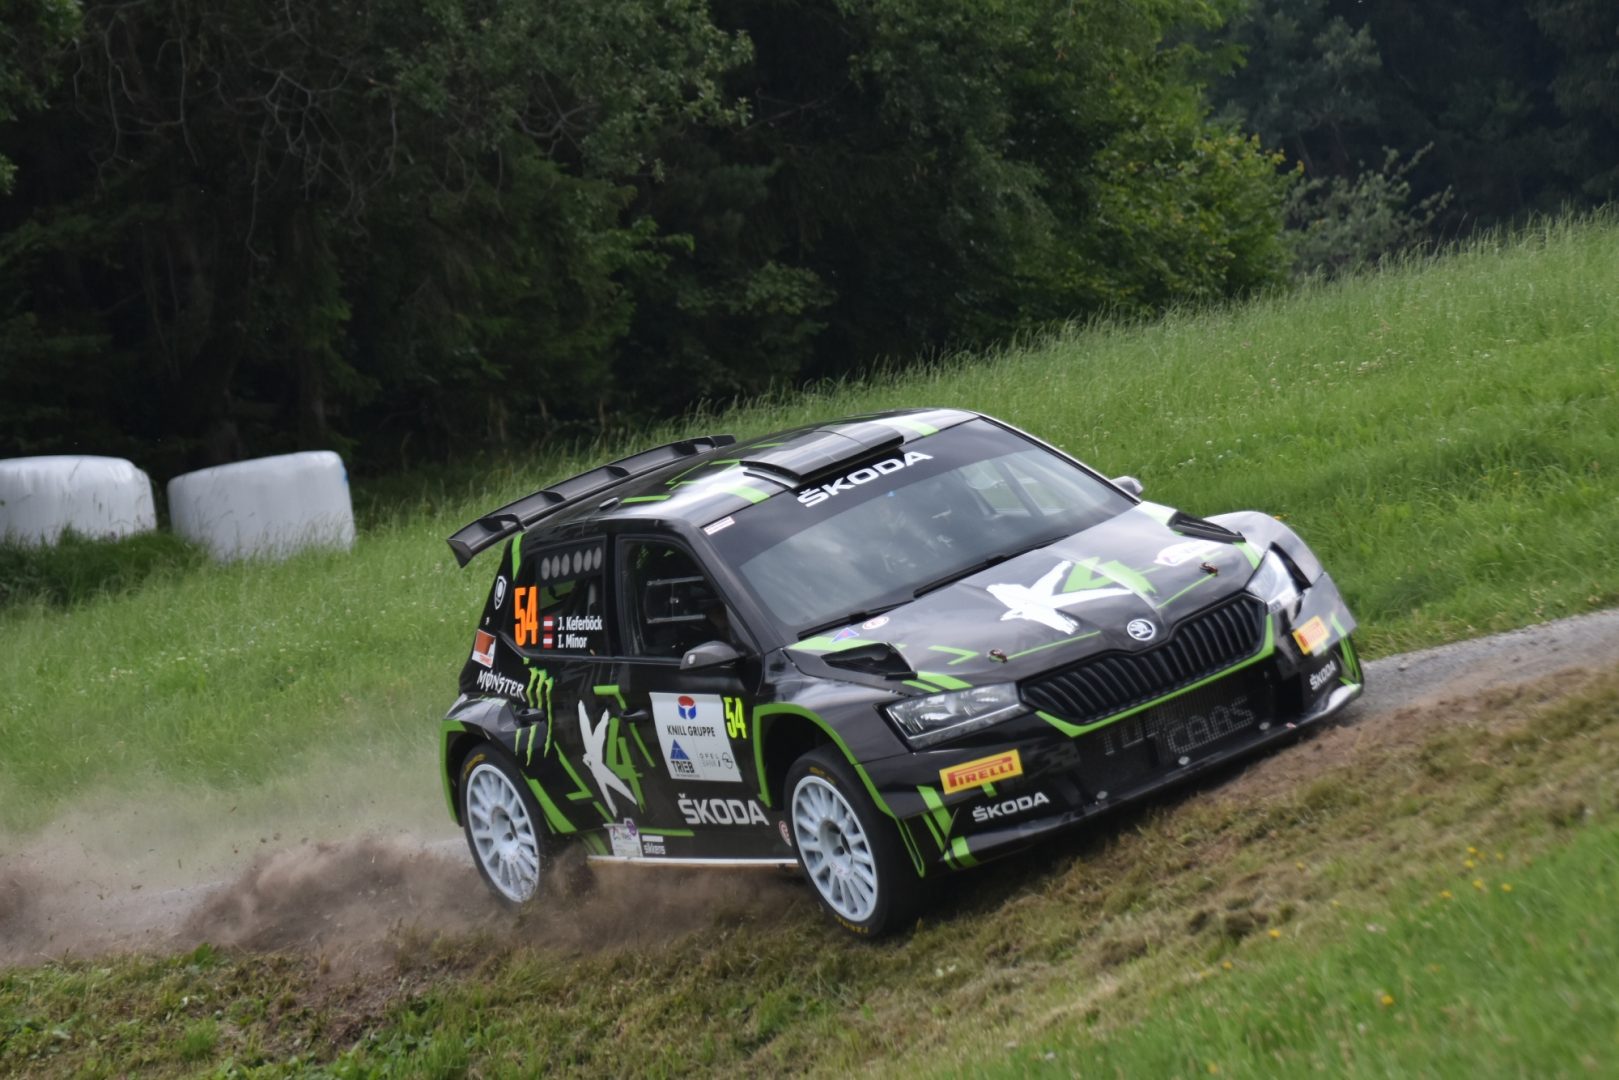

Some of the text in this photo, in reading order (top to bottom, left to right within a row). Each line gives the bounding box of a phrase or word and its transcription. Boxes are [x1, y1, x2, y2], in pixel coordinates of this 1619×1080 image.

[797, 451, 934, 507] ŠKODA
[514, 586, 539, 647] 54
[566, 615, 603, 631] Keferböck
[566, 634, 587, 648] Minor
[667, 725, 716, 737] KNILL GRUPPE
[723, 696, 747, 739] 54
[671, 760, 695, 774] TRIEB
[946, 756, 1014, 788] PIRELLI
[678, 793, 770, 826] ŠKODA
[972, 791, 1050, 822] ŠKODA
